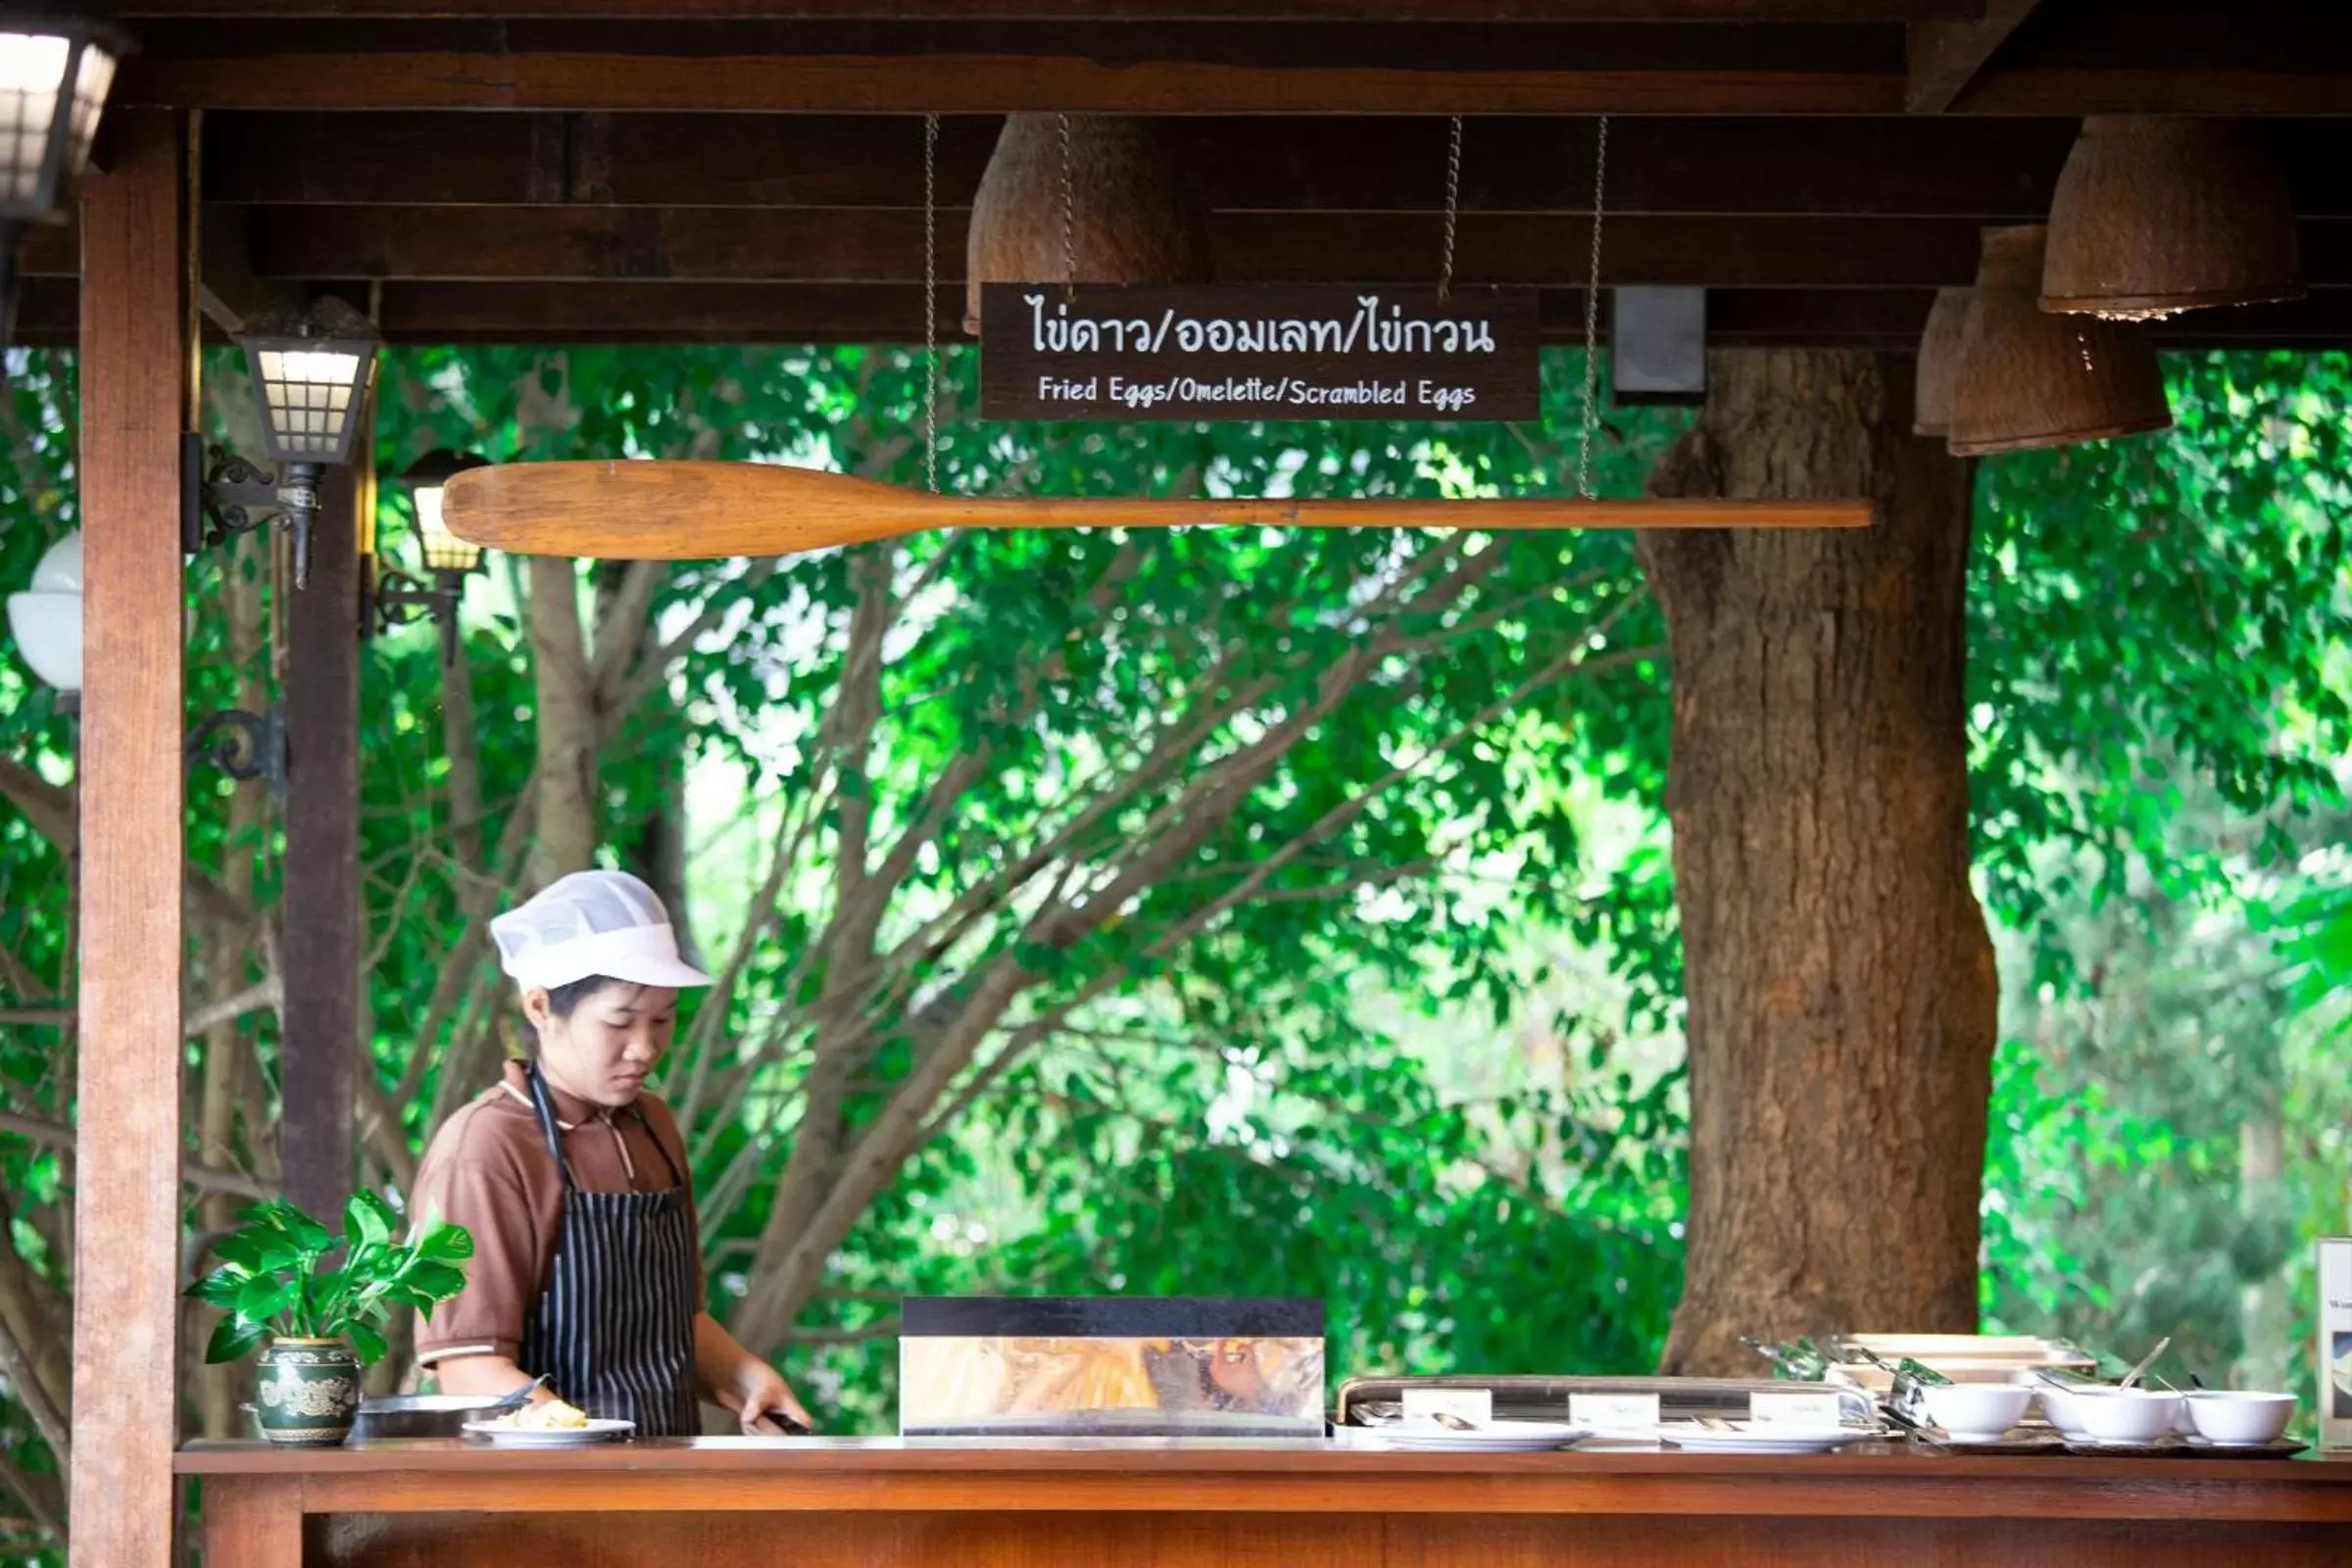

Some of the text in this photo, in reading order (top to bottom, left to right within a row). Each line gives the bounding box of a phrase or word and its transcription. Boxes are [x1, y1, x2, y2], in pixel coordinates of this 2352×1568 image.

[1023, 294, 1495, 353] ไข่ดาว/ออมเลท/ไข่กวน
[1039, 375, 1476, 411] Fried Eggs/Omelette/Scrambled Eggs
